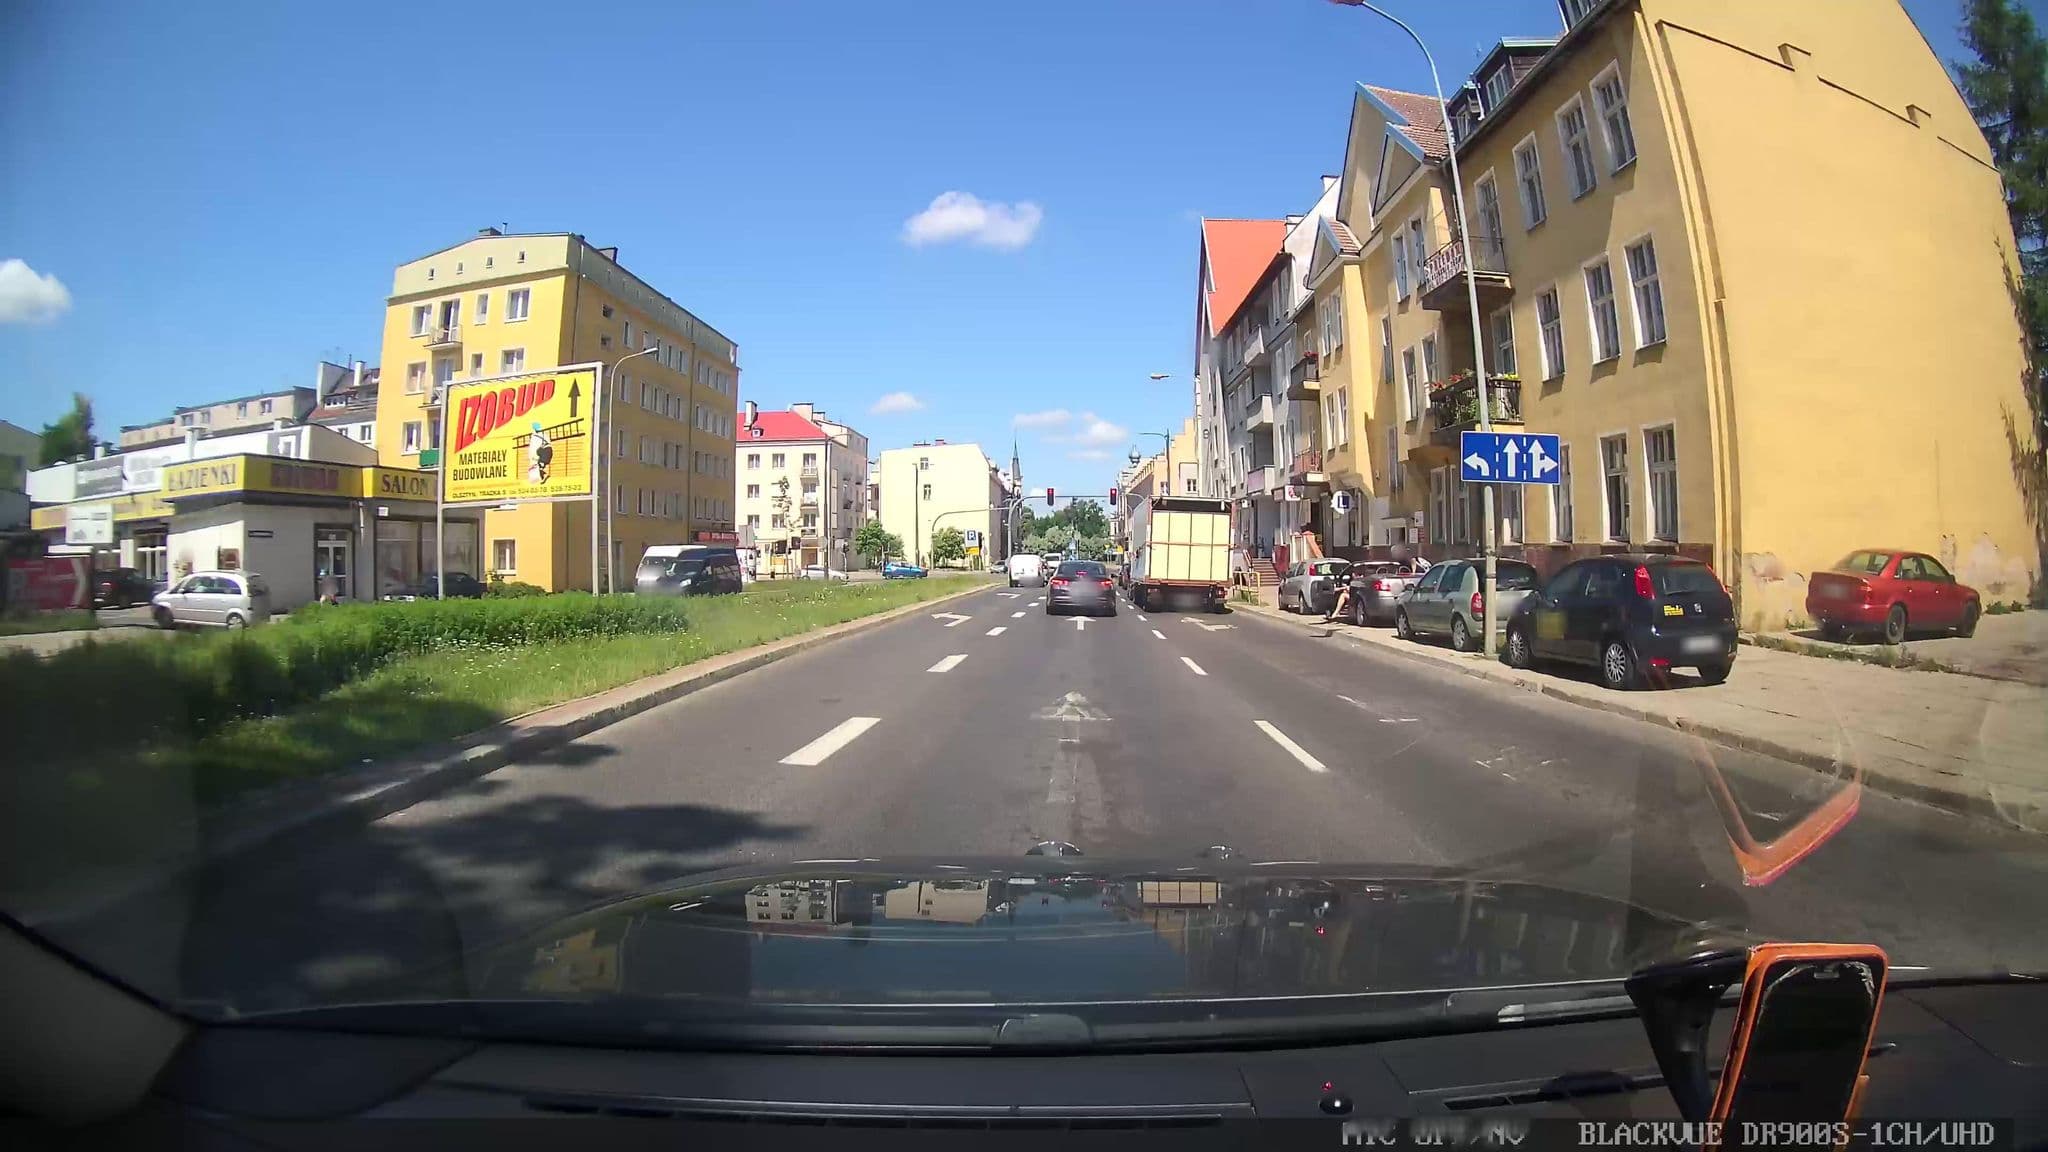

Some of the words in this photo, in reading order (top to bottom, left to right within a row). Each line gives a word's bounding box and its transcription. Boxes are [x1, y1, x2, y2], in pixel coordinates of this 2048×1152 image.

[454, 379, 556, 454] IZOBUD
[459, 447, 507, 466] MATERIAŁY
[453, 465, 507, 481] BUDOWLANE
[382, 474, 430, 496] SALON
